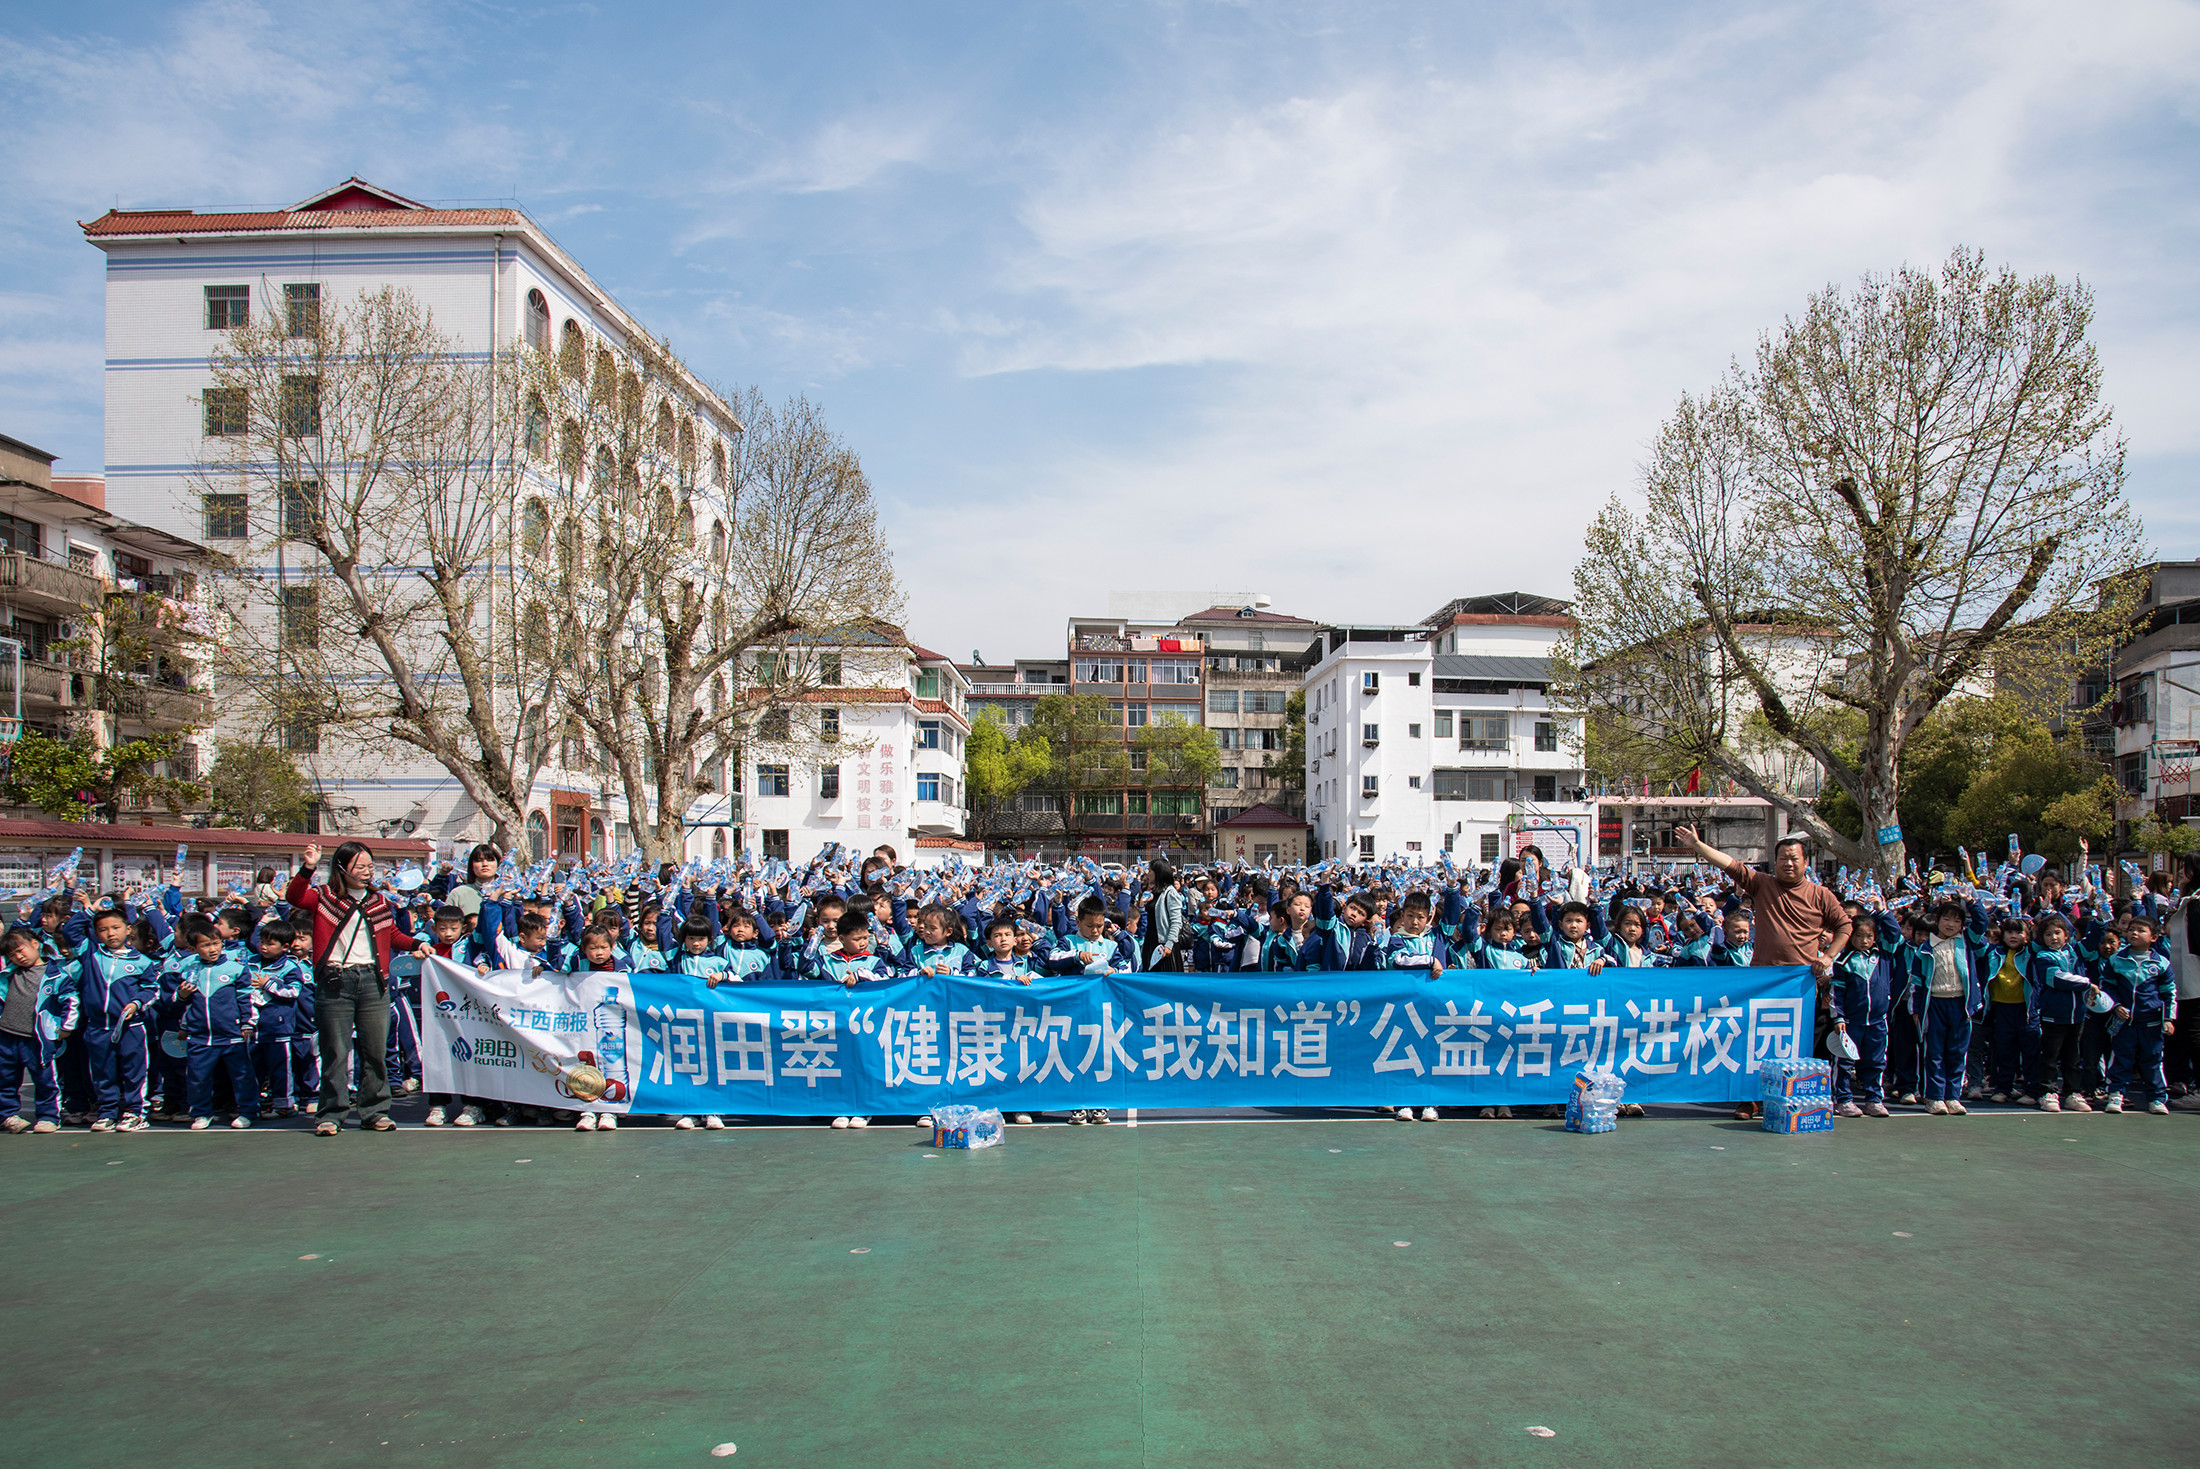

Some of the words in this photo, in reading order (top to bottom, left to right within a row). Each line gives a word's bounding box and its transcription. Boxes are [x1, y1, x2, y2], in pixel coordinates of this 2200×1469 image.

[880, 744, 894, 829] 做乐雅少年
[508, 1007, 588, 1033] 江西商报
[646, 996, 1803, 1088] 润田翠“健康饮水我知道”公益活动进校园
[474, 1038, 517, 1059] 润田
